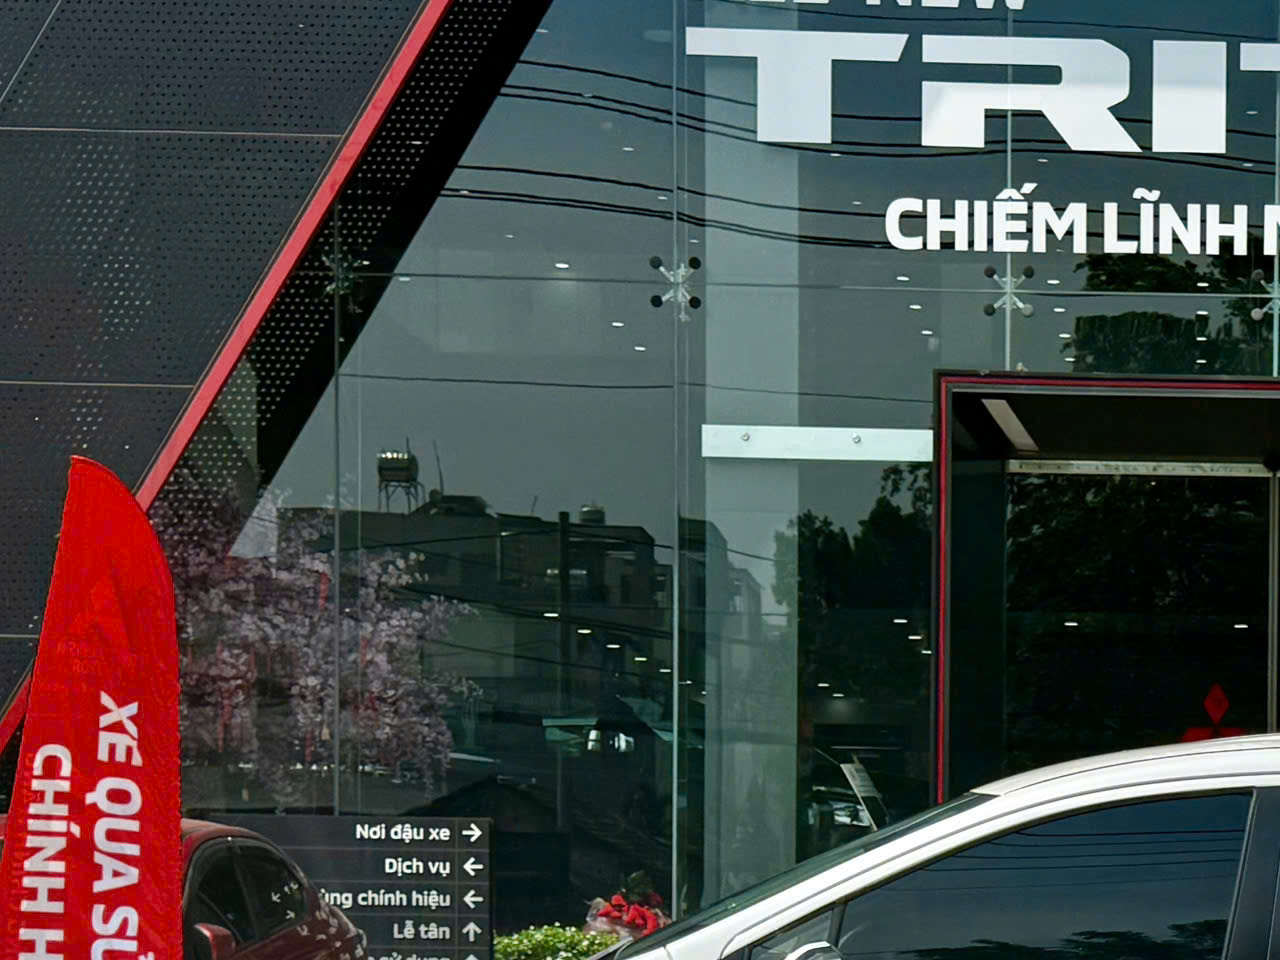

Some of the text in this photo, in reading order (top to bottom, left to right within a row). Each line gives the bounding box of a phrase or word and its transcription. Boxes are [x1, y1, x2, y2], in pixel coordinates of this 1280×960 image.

[885, 182, 1088, 254] CHIẾM
[1103, 187, 1249, 257] LĨNH
[97, 690, 143, 767] XE
[20, 743, 81, 914] CHÍNH
[85, 776, 143, 894] QUA
[356, 823, 450, 844] Nơi đậu xe
[385, 858, 450, 877] Dịch vụ
[357, 889, 407, 907] chính
[412, 890, 450, 910] hiệu
[393, 920, 450, 940] Lễ tân
